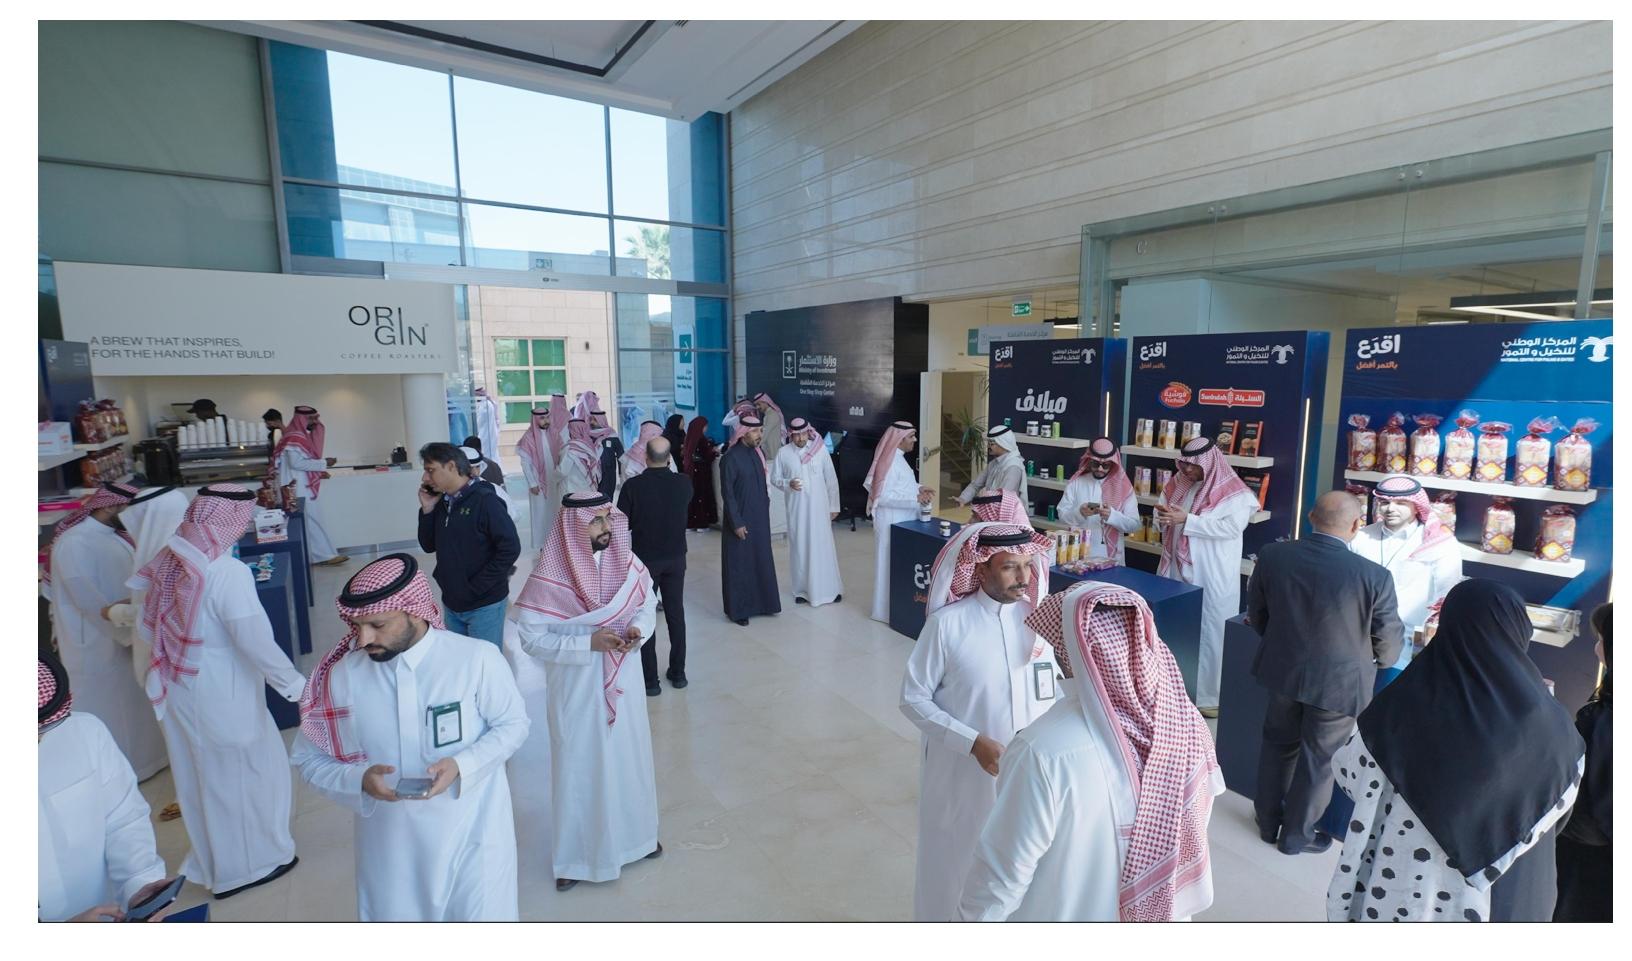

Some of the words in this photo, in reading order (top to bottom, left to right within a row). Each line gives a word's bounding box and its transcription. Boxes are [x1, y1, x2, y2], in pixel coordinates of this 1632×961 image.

[91, 336, 99, 345] A
[102, 336, 143, 346] BREW
[146, 336, 180, 346] THAT
[91, 349, 122, 359] FOR
[125, 350, 151, 359] THE
[154, 350, 201, 359] HANDS
[203, 350, 234, 359] THAT
[237, 350, 275, 359] BUILD!
[1015, 388, 1068, 420] ميلاف
